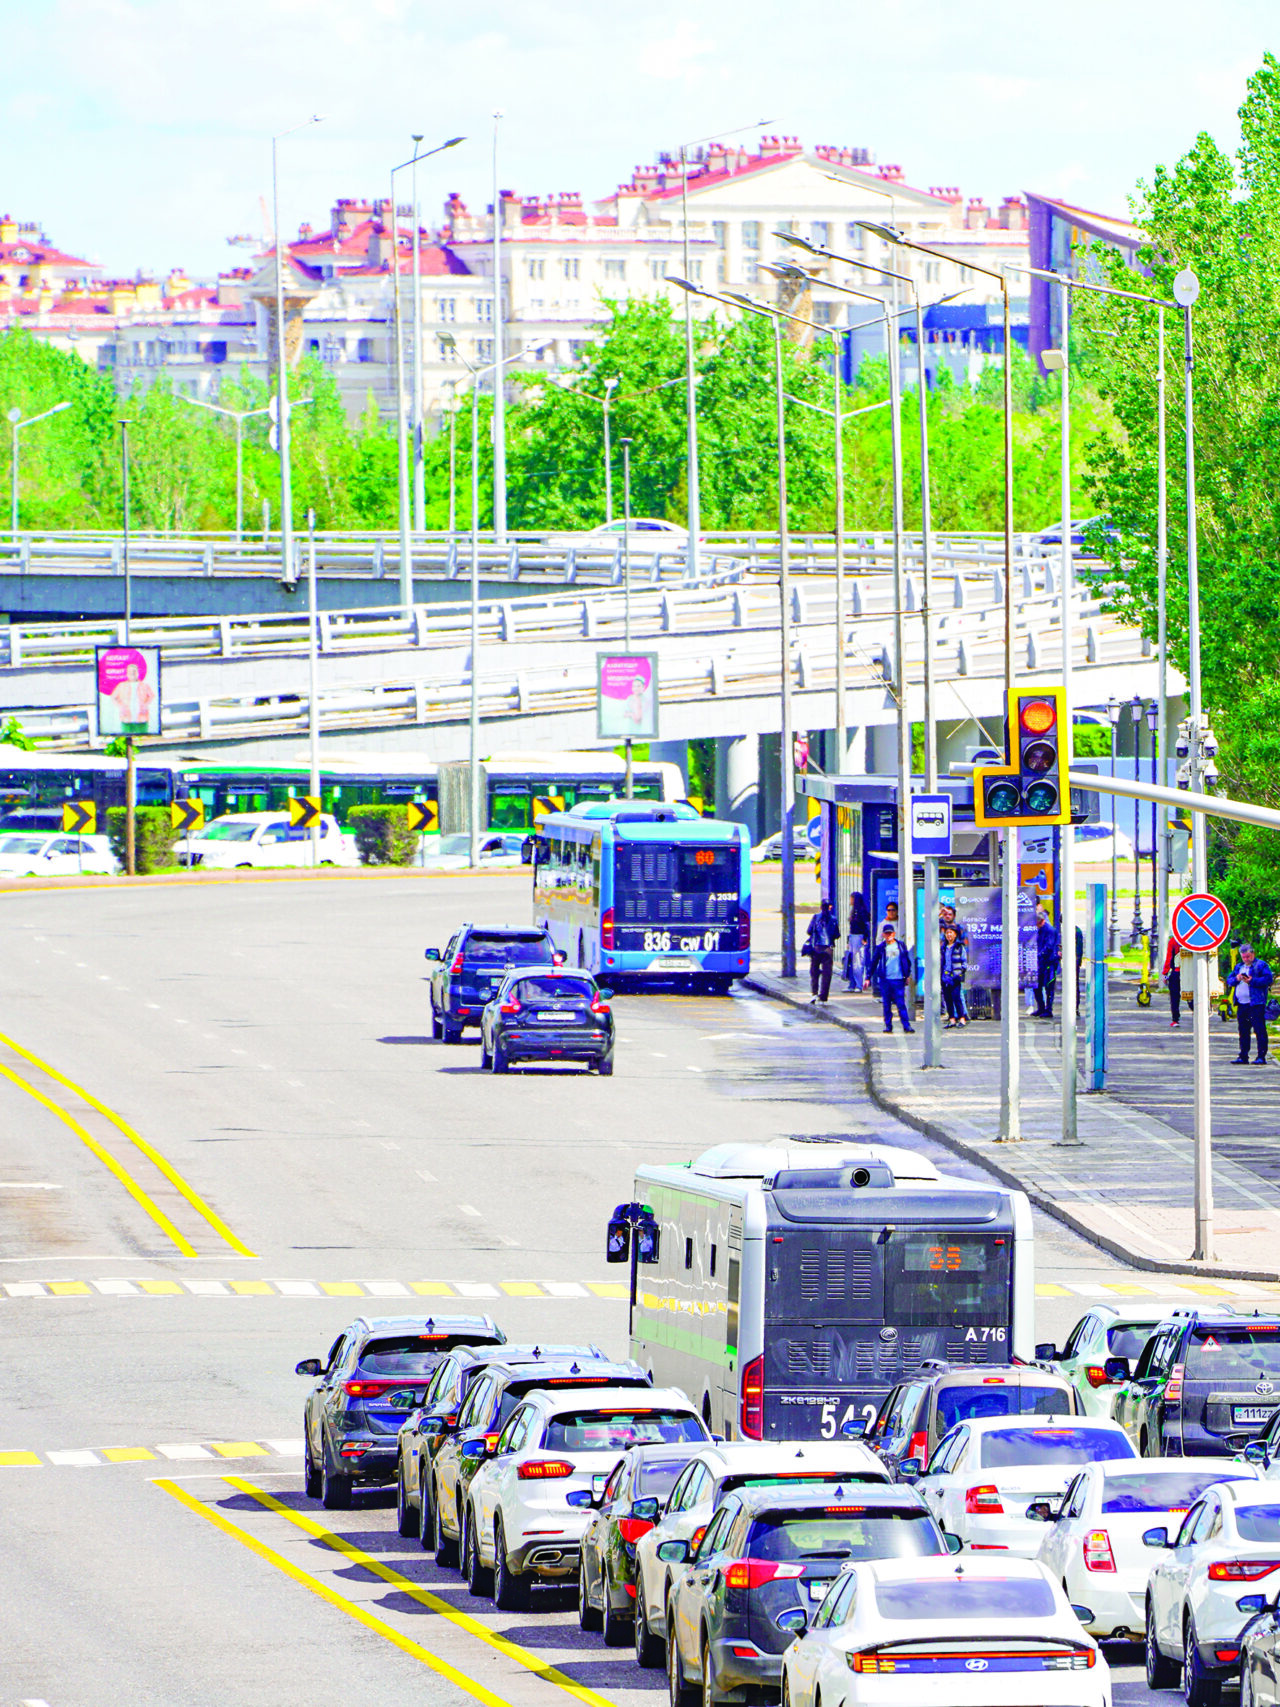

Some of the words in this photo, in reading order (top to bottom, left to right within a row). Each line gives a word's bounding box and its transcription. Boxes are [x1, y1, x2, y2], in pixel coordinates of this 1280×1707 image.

[708, 893, 716, 901] A
[717, 892, 738, 901] 2036
[966, 923, 987, 933] 19,7
[643, 931, 671, 951] 836
[704, 931, 720, 951] 01
[929, 1247, 962, 1270] 35
[965, 1328, 978, 1341] A
[980, 1328, 1006, 1342] 716
